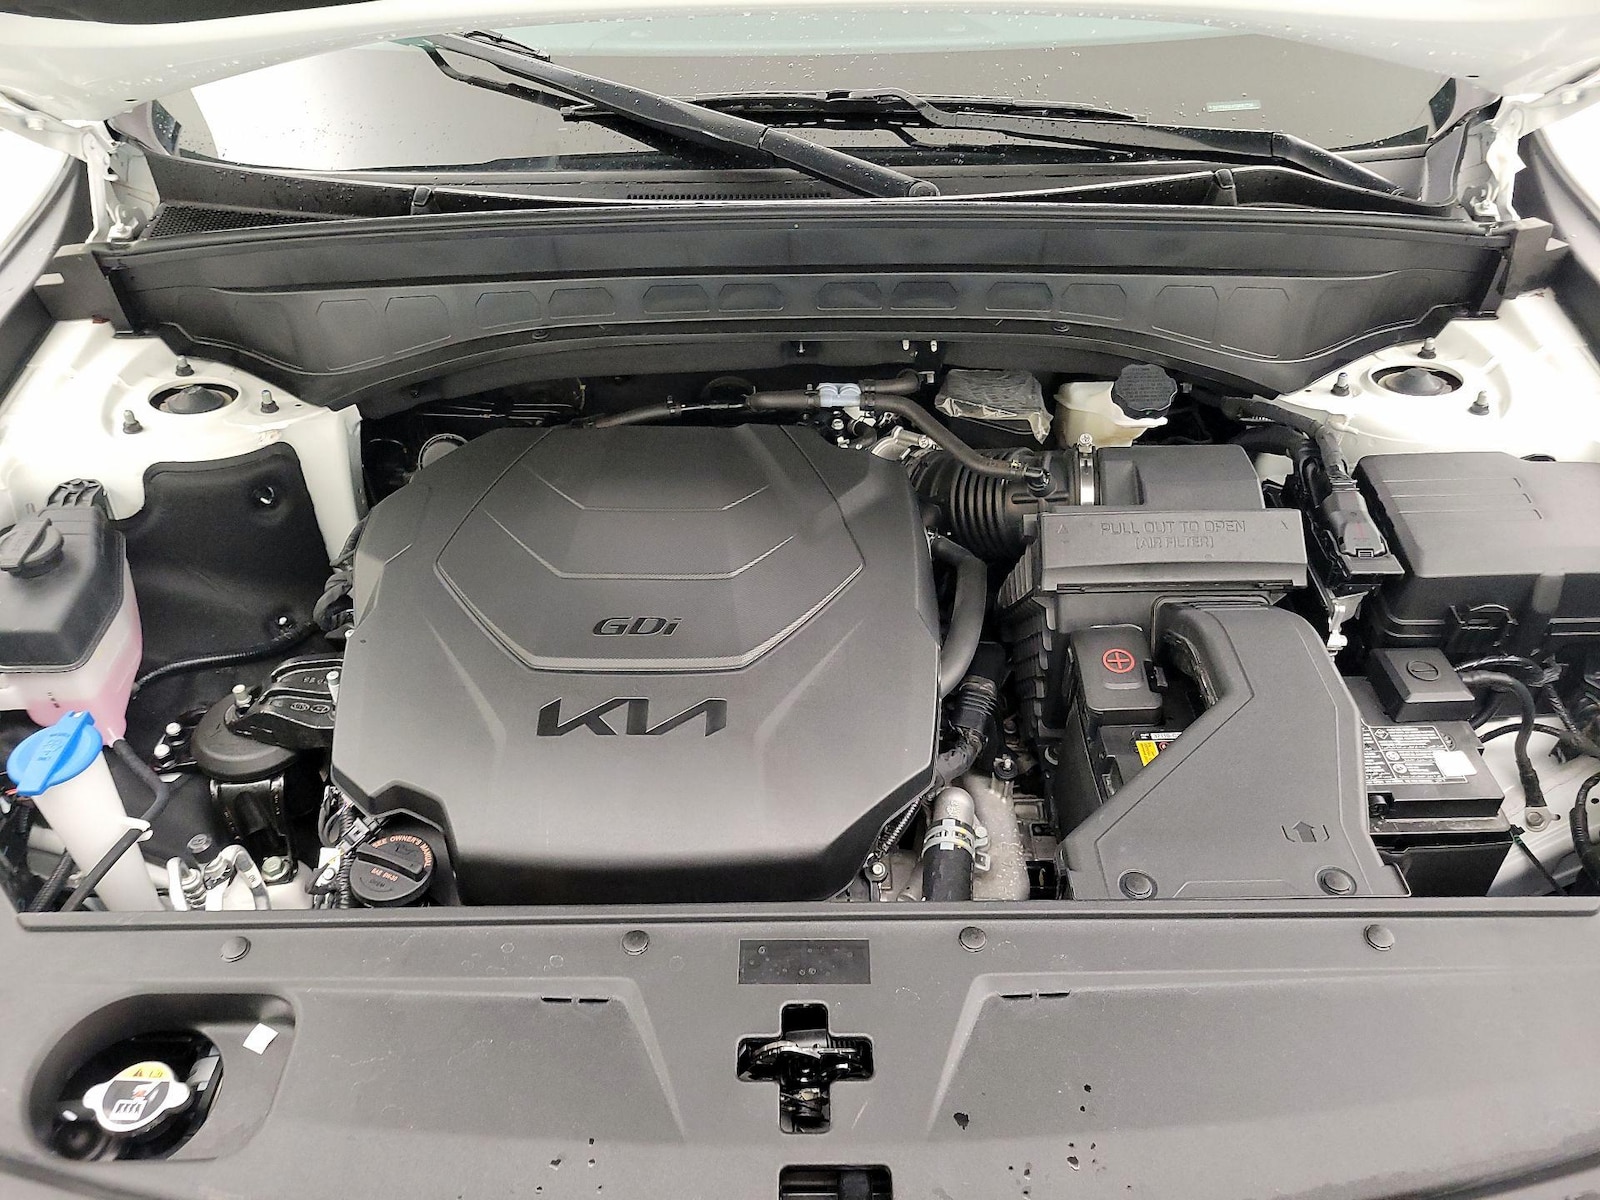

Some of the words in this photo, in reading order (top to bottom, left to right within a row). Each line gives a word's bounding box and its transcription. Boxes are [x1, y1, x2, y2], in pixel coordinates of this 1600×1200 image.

[1100, 521, 1140, 535] PULL
[1144, 520, 1175, 533] OUT
[1181, 520, 1200, 533] TO
[1204, 519, 1246, 533] OPEN
[1135, 537, 1161, 550] (AIR
[1166, 536, 1215, 549] FILTER)
[592, 616, 682, 637] GDi
[536, 696, 728, 737] KIA
[390, 835, 422, 845] OWNER'S
[420, 843, 432, 868] MANUAL
